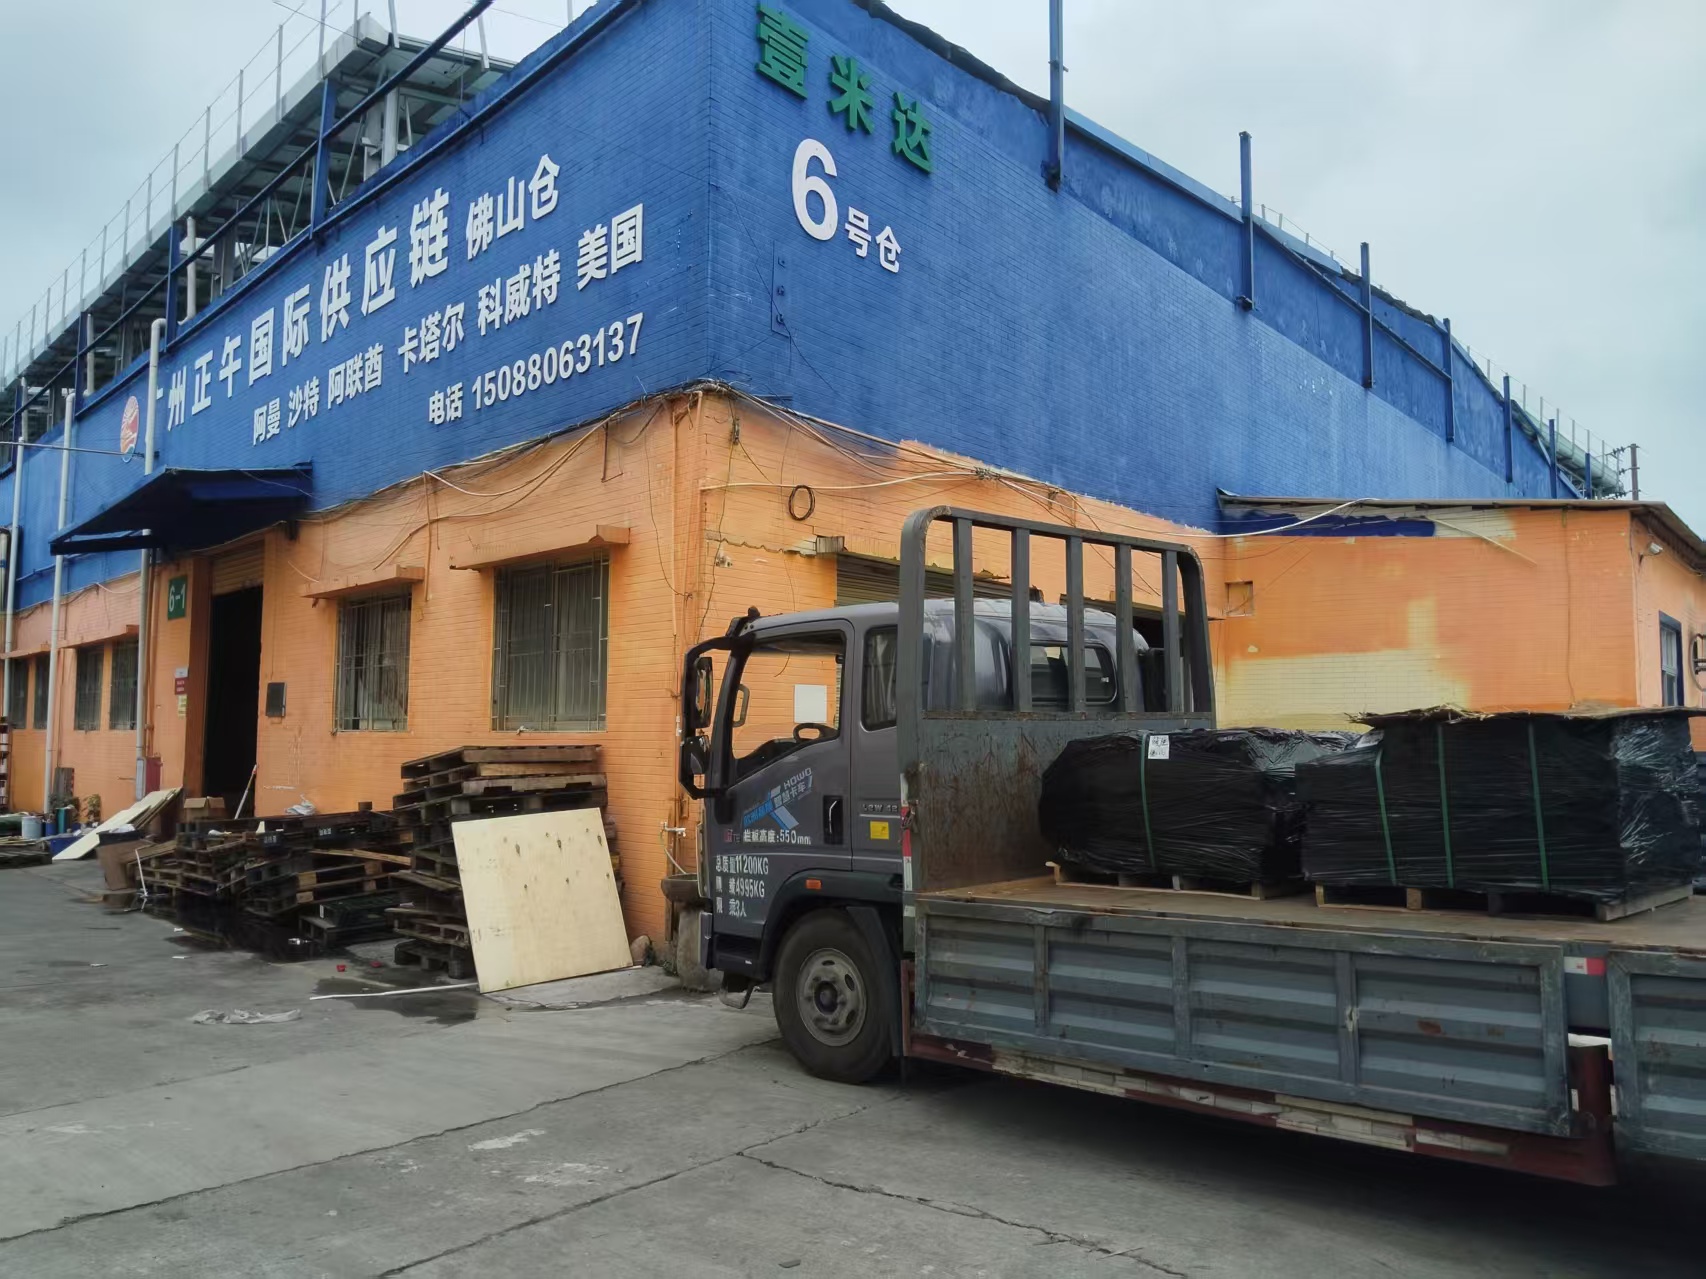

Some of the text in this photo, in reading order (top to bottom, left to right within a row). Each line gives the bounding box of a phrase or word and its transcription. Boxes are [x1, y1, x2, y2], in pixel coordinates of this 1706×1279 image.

[754, 0, 933, 176] 壹米达
[156, 153, 560, 432] 州正午国际供应链 佛山仓
[253, 203, 643, 446] 阿曼 沙特 阿联酋 卡塔尔 科威特 美国
[428, 312, 643, 425] 电话 15088063137
[168, 583, 186, 612] 6-1
[783, 767, 812, 790] HOWO
